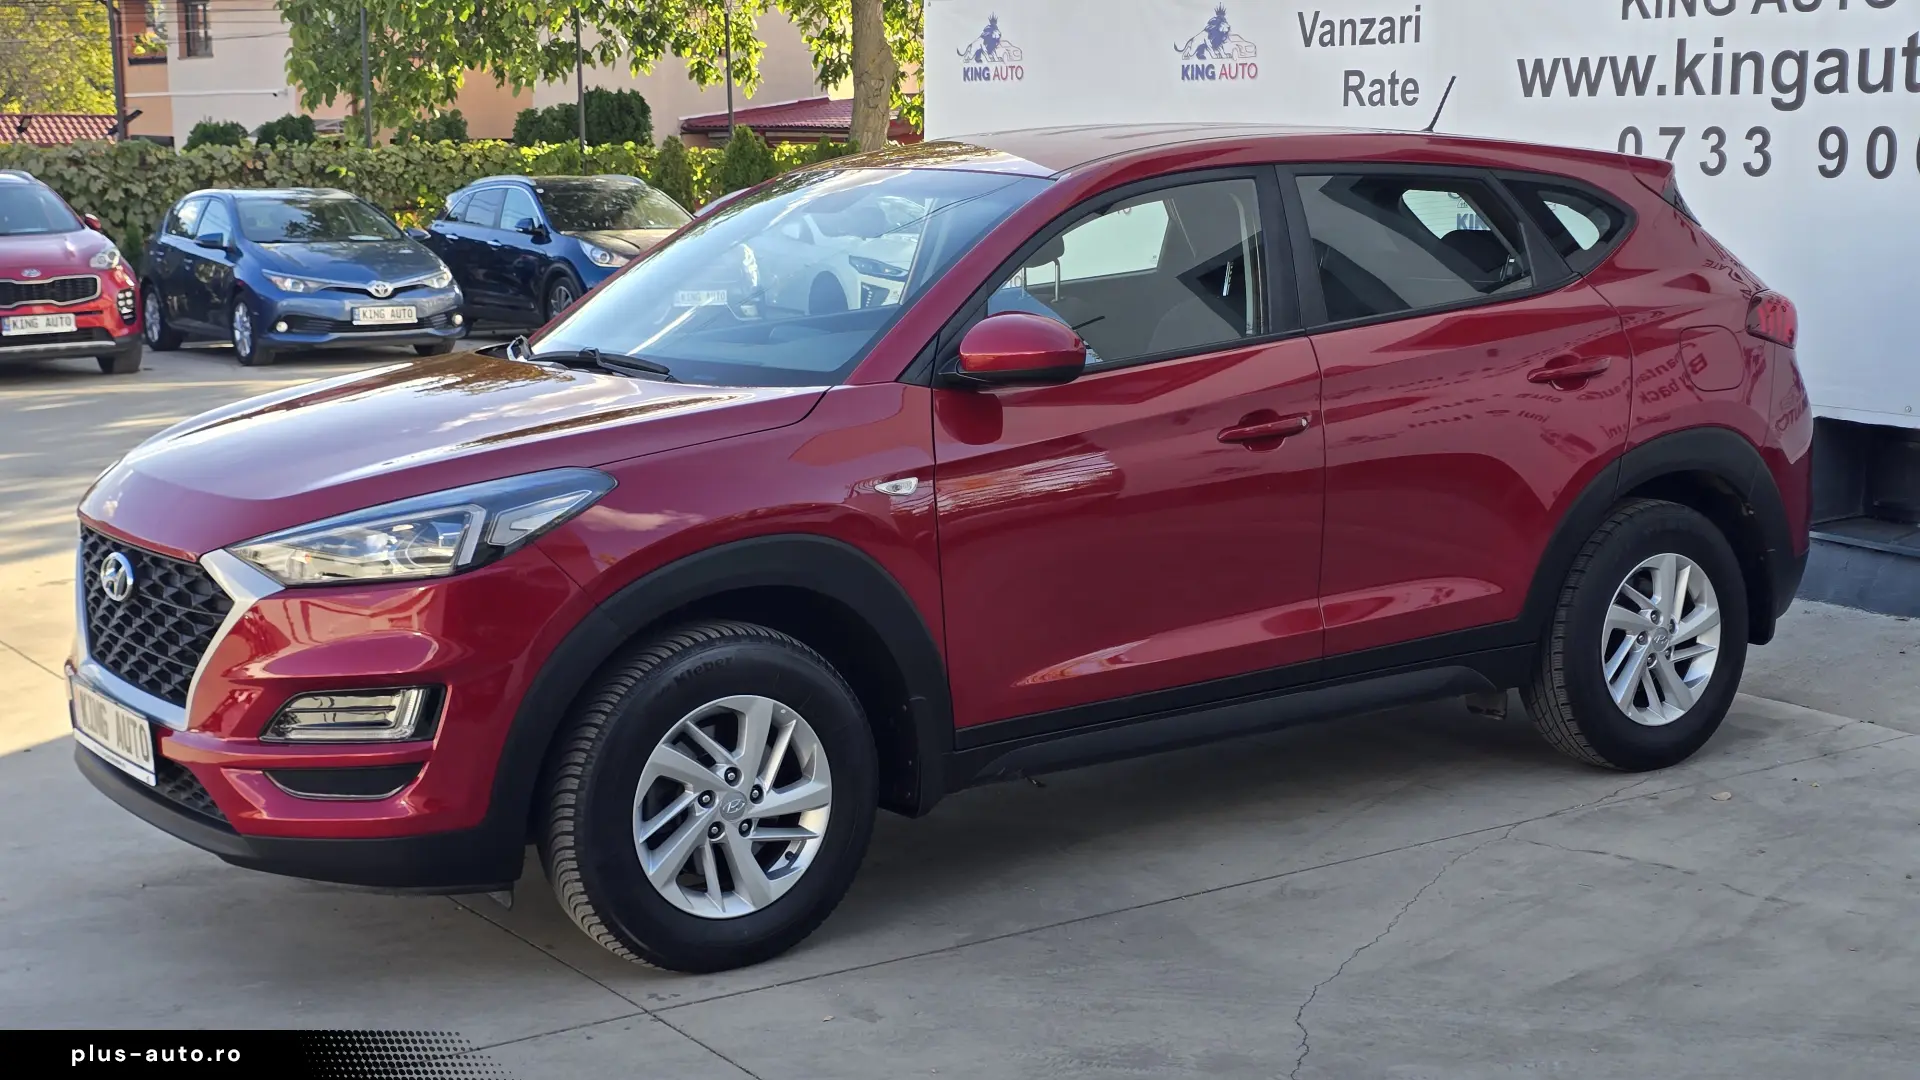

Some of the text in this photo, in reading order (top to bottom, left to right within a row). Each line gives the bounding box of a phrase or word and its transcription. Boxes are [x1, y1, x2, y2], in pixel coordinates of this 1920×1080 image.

[1298, 4, 1421, 47] Vanzari
[963, 65, 1024, 81] KING AUTO
[1181, 62, 1258, 81] KING AUTO
[1516, 31, 1920, 111] www.kingaut
[1343, 69, 1420, 107] Rate
[1818, 125, 1920, 180] 90
[12, 316, 72, 330] KING AUTO
[362, 308, 413, 319] KING AUTO
[673, 655, 735, 681] Kleber
[79, 690, 109, 742] KING
[115, 709, 150, 762] AUTO
